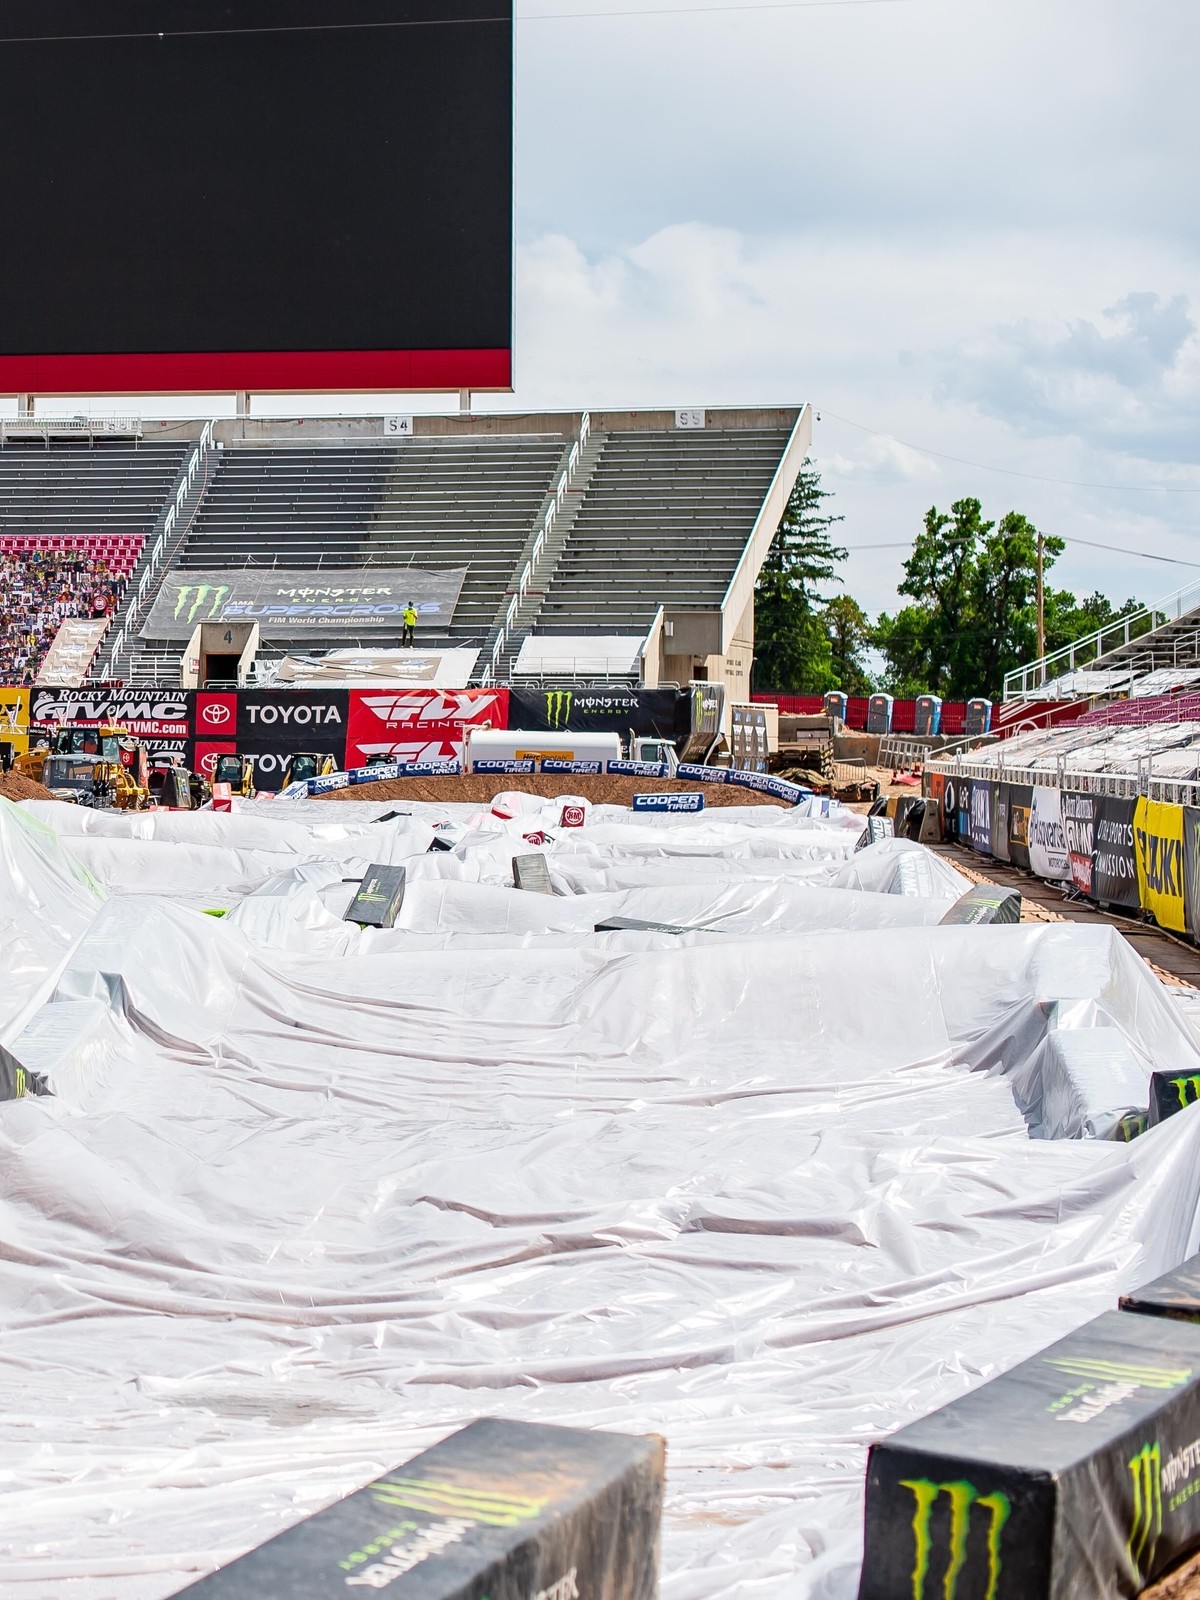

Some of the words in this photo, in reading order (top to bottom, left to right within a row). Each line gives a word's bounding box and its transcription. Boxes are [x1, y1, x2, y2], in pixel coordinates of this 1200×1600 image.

[276, 586, 393, 598] MONSTER
[288, 616, 317, 624] World
[318, 615, 385, 625] Championship
[223, 630, 232, 644] 4
[58, 690, 106, 701] ROCKY
[107, 689, 188, 701] MOUNTAIN
[574, 697, 639, 708] MONSTER
[246, 705, 342, 724] TOYOTA
[386, 720, 466, 729] RACING
[405, 761, 458, 771] COOPER
[478, 760, 533, 768] COOPER
[543, 760, 600, 769] COOPER
[609, 761, 662, 771] COOPER
[357, 765, 399, 778] COOPER
[678, 765, 727, 778] COOPER
[700, 774, 726, 783] TIRES
[733, 772, 769, 785] COOPER
[768, 780, 800, 797] COOPER
[636, 794, 700, 805] COOPER
